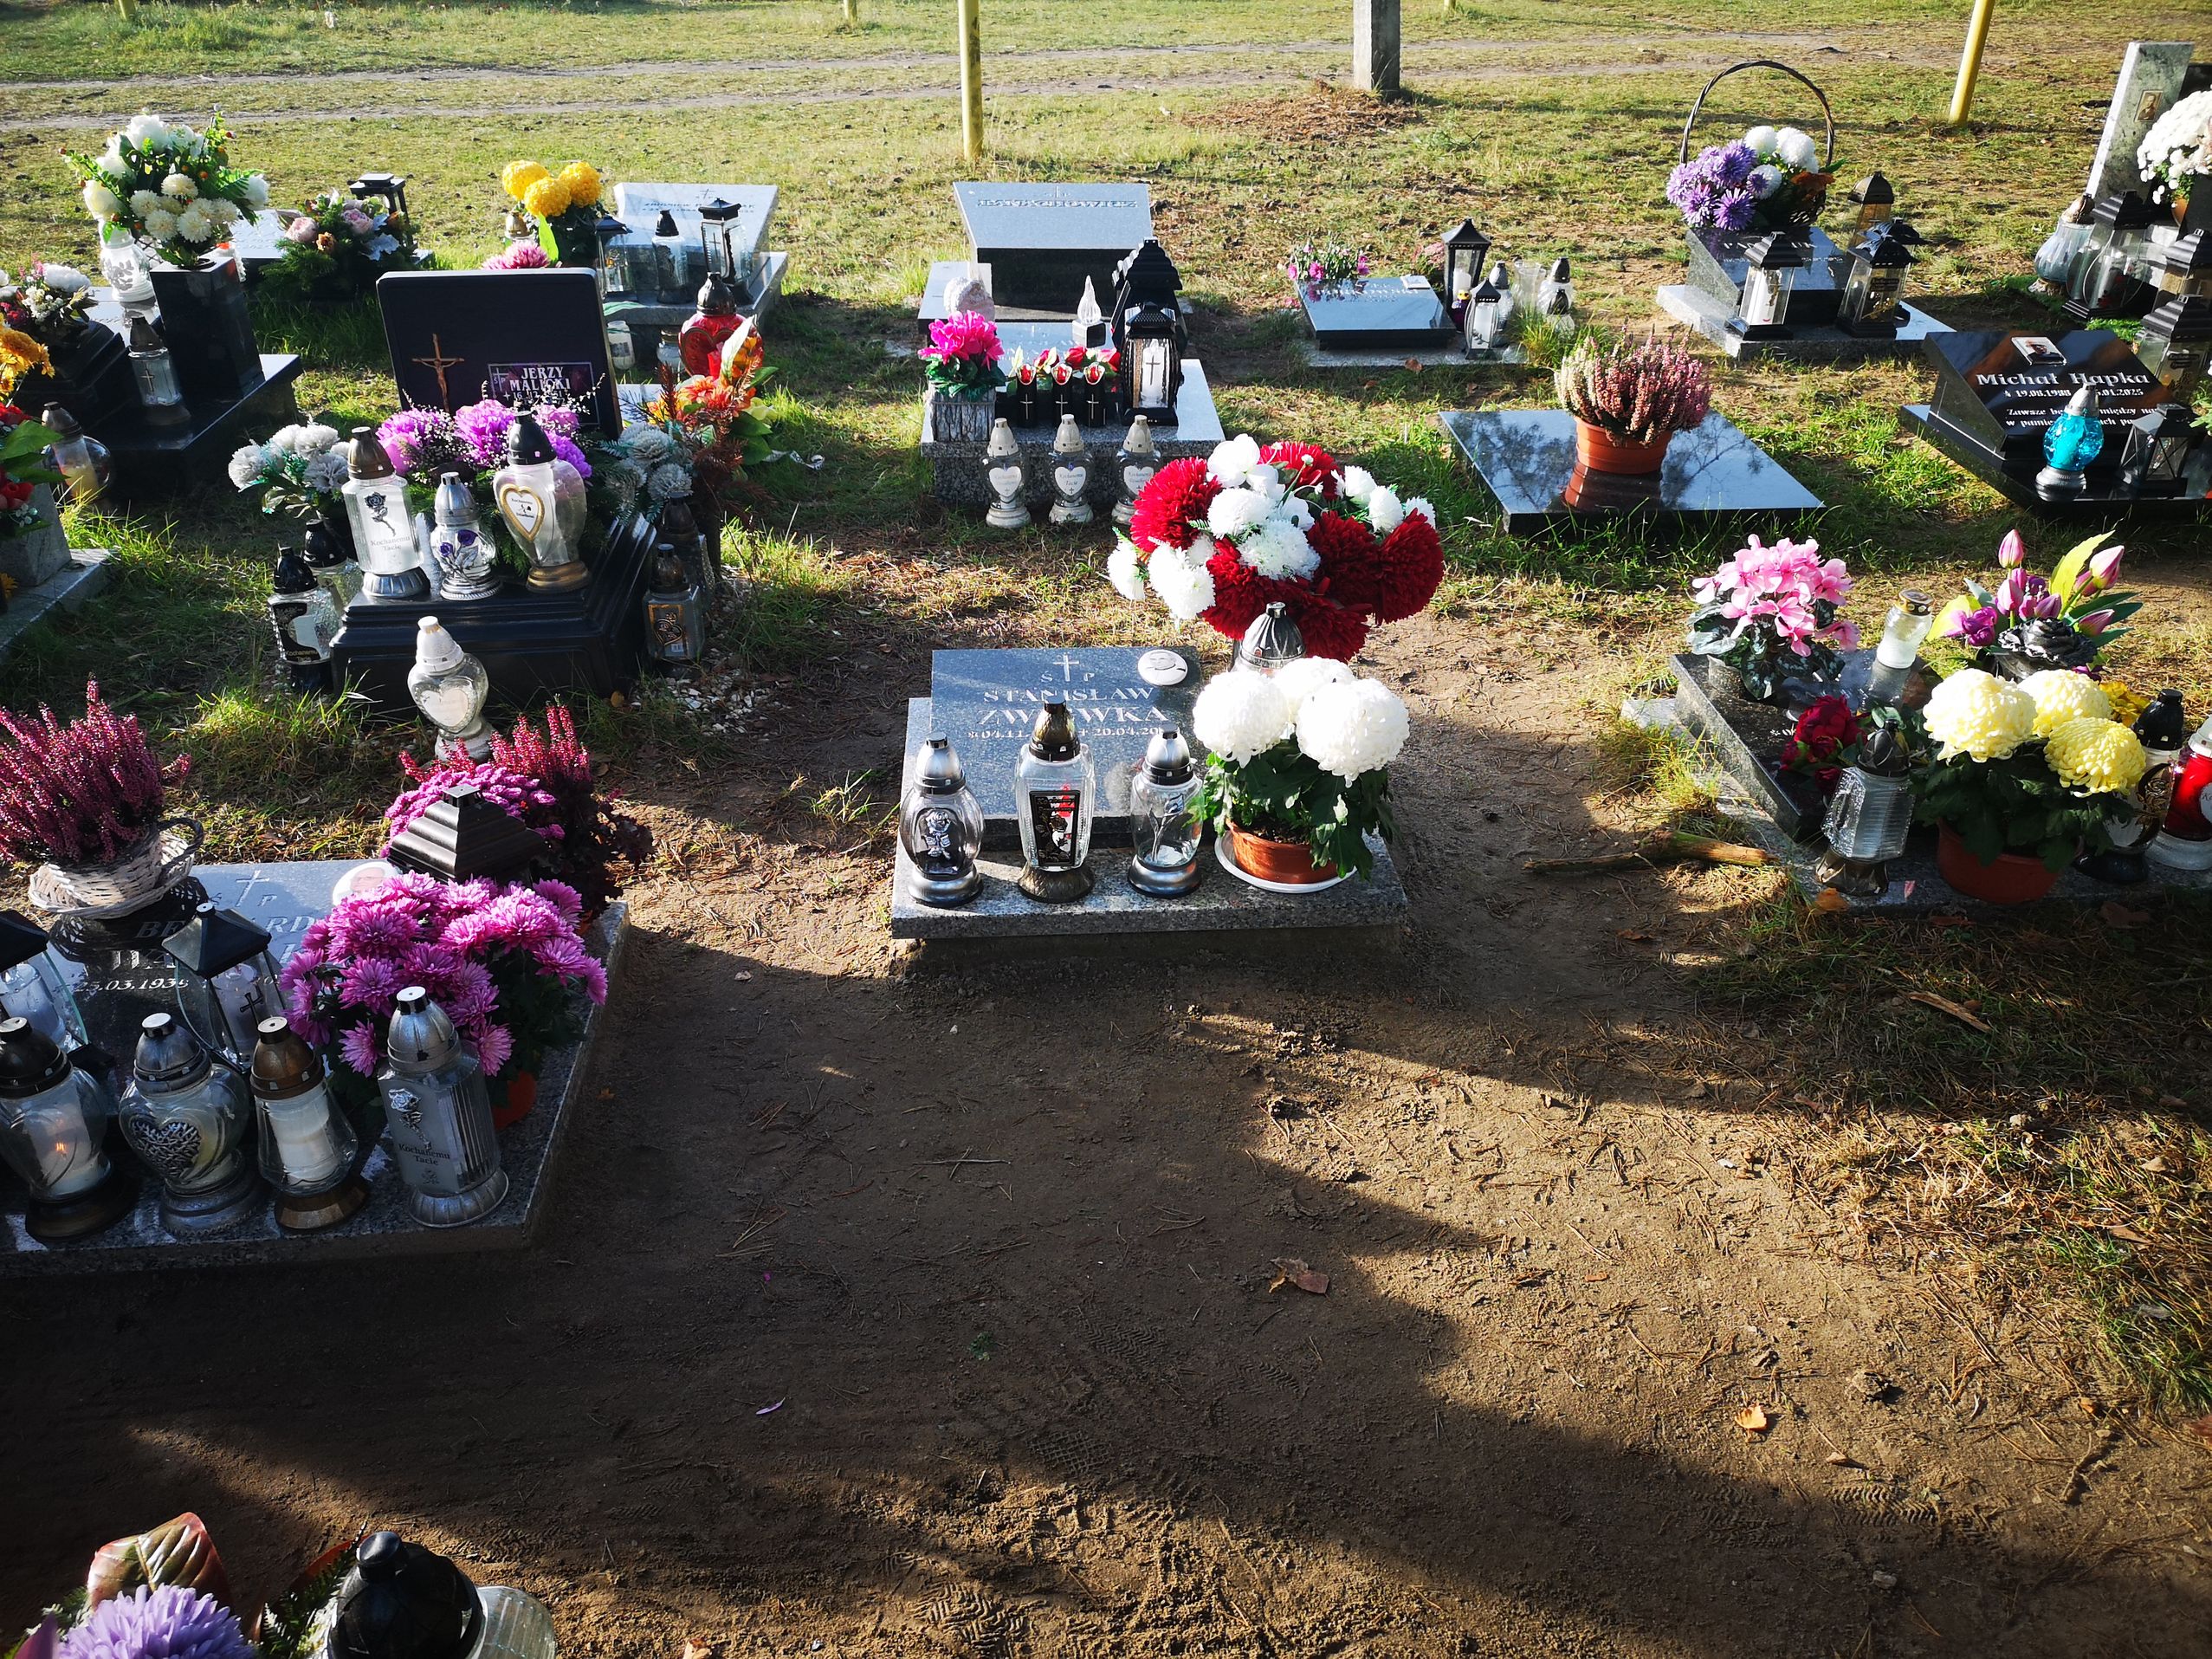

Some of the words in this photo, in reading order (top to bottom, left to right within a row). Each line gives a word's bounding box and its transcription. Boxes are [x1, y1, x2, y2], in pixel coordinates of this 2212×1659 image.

[521, 366, 564, 379] JERZY
[1976, 372, 2060, 386] Michał
[2068, 372, 2151, 386] Hapka
[2015, 388, 2072, 398] 19.08.1988
[398, 1144, 450, 1160] Kochanemu
[414, 1155, 439, 1166] Tacie
